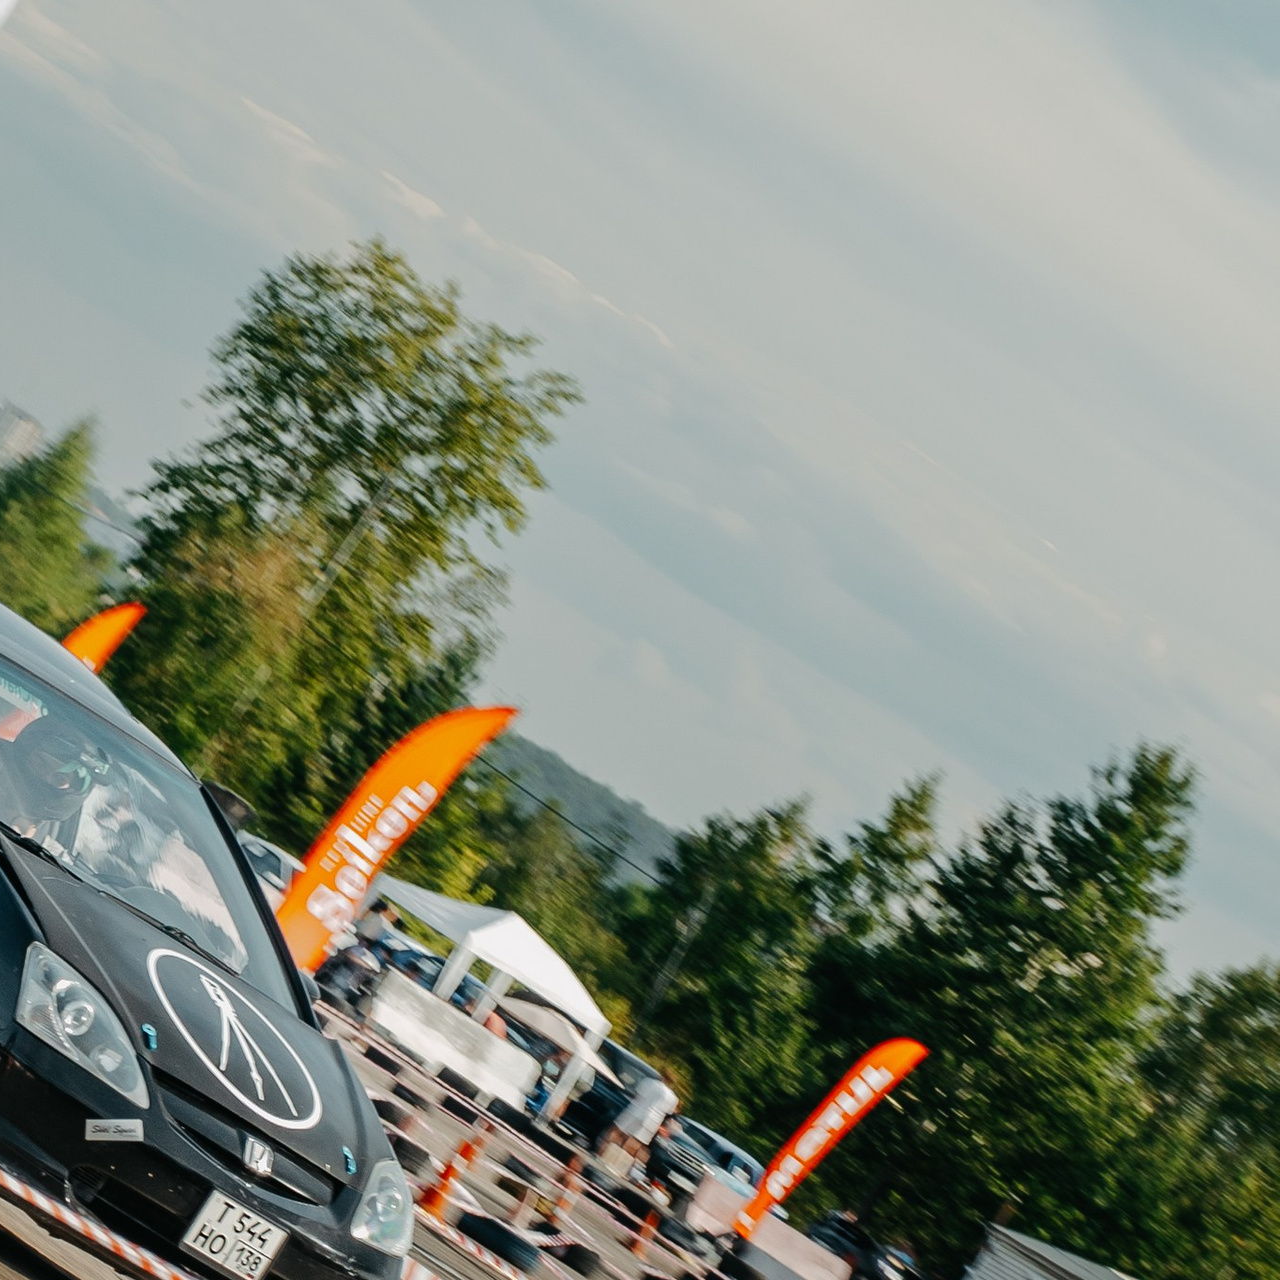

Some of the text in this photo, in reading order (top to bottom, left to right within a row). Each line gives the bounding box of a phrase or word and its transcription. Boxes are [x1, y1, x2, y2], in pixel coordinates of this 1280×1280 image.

[766, 1064, 893, 1200] MOTUL
[233, 1212, 272, 1248] 544
[236, 1247, 261, 1271] 138
